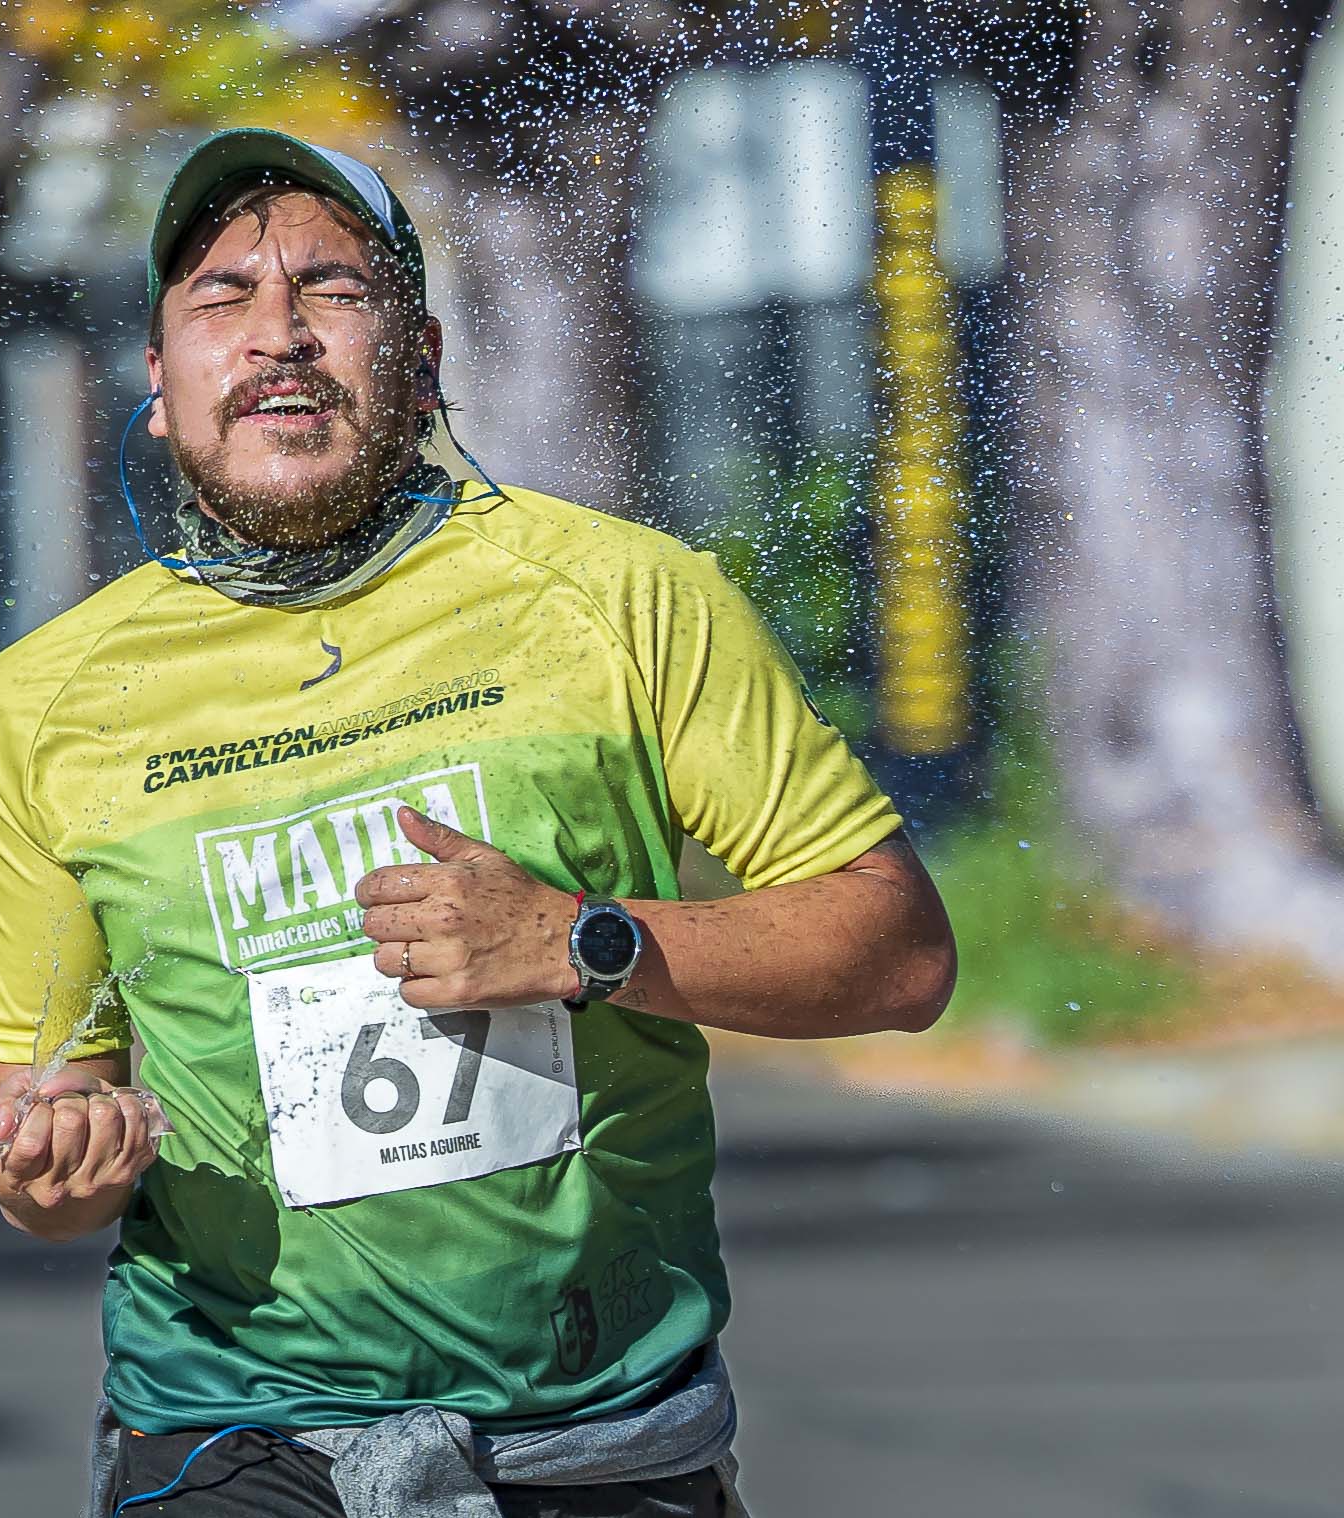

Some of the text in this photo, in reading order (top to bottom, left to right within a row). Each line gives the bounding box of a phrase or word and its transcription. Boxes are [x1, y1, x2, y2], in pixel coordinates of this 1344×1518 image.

[314, 668, 500, 738] ANIVERSARIO
[237, 915, 341, 961] Almacenes
[341, 1009, 492, 1134] 67
[379, 1132, 482, 1165] MATIAS AGUIRRE
